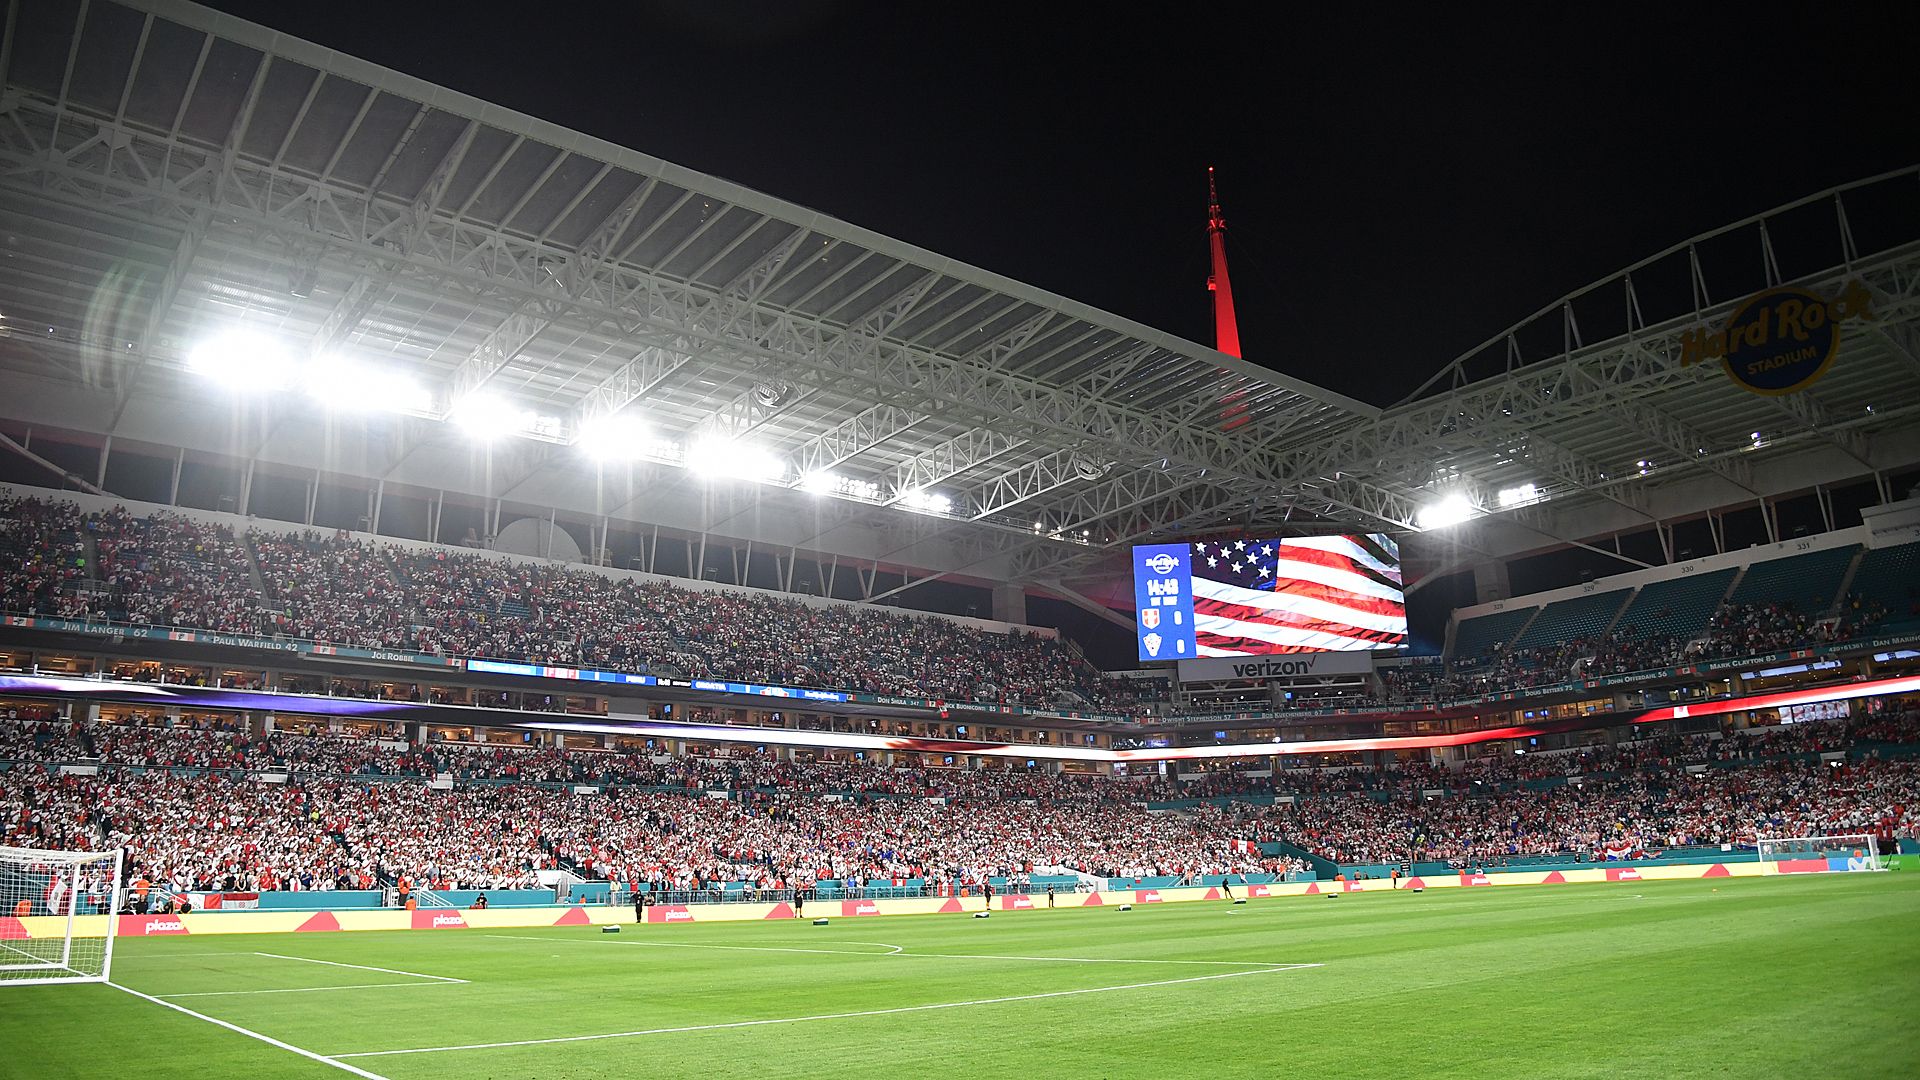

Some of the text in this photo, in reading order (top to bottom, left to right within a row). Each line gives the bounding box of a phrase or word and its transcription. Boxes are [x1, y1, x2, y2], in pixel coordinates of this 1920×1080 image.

[1680, 279, 1873, 367] Hard Rock
[1747, 346, 1817, 375] STADIUM
[1796, 543, 1810, 551] 331
[1681, 565, 1694, 574] 330
[1583, 584, 1595, 593] 329
[62, 621, 148, 637] JIM LANGER 62
[212, 636, 298, 651] PAUL WARFIELD 42
[1872, 639, 1890, 647] DAN
[371, 651, 414, 662] JOE ROBBIE
[1709, 654, 1777, 670] MARK CLAYTON 83
[1233, 658, 1308, 677] verizon
[1624, 673, 1657, 682] OFFERDAHL
[877, 696, 890, 704] DON
[1454, 698, 1485, 707] BAUMHOWE
[145, 919, 183, 934] plaza
[433, 914, 462, 928] plaza
